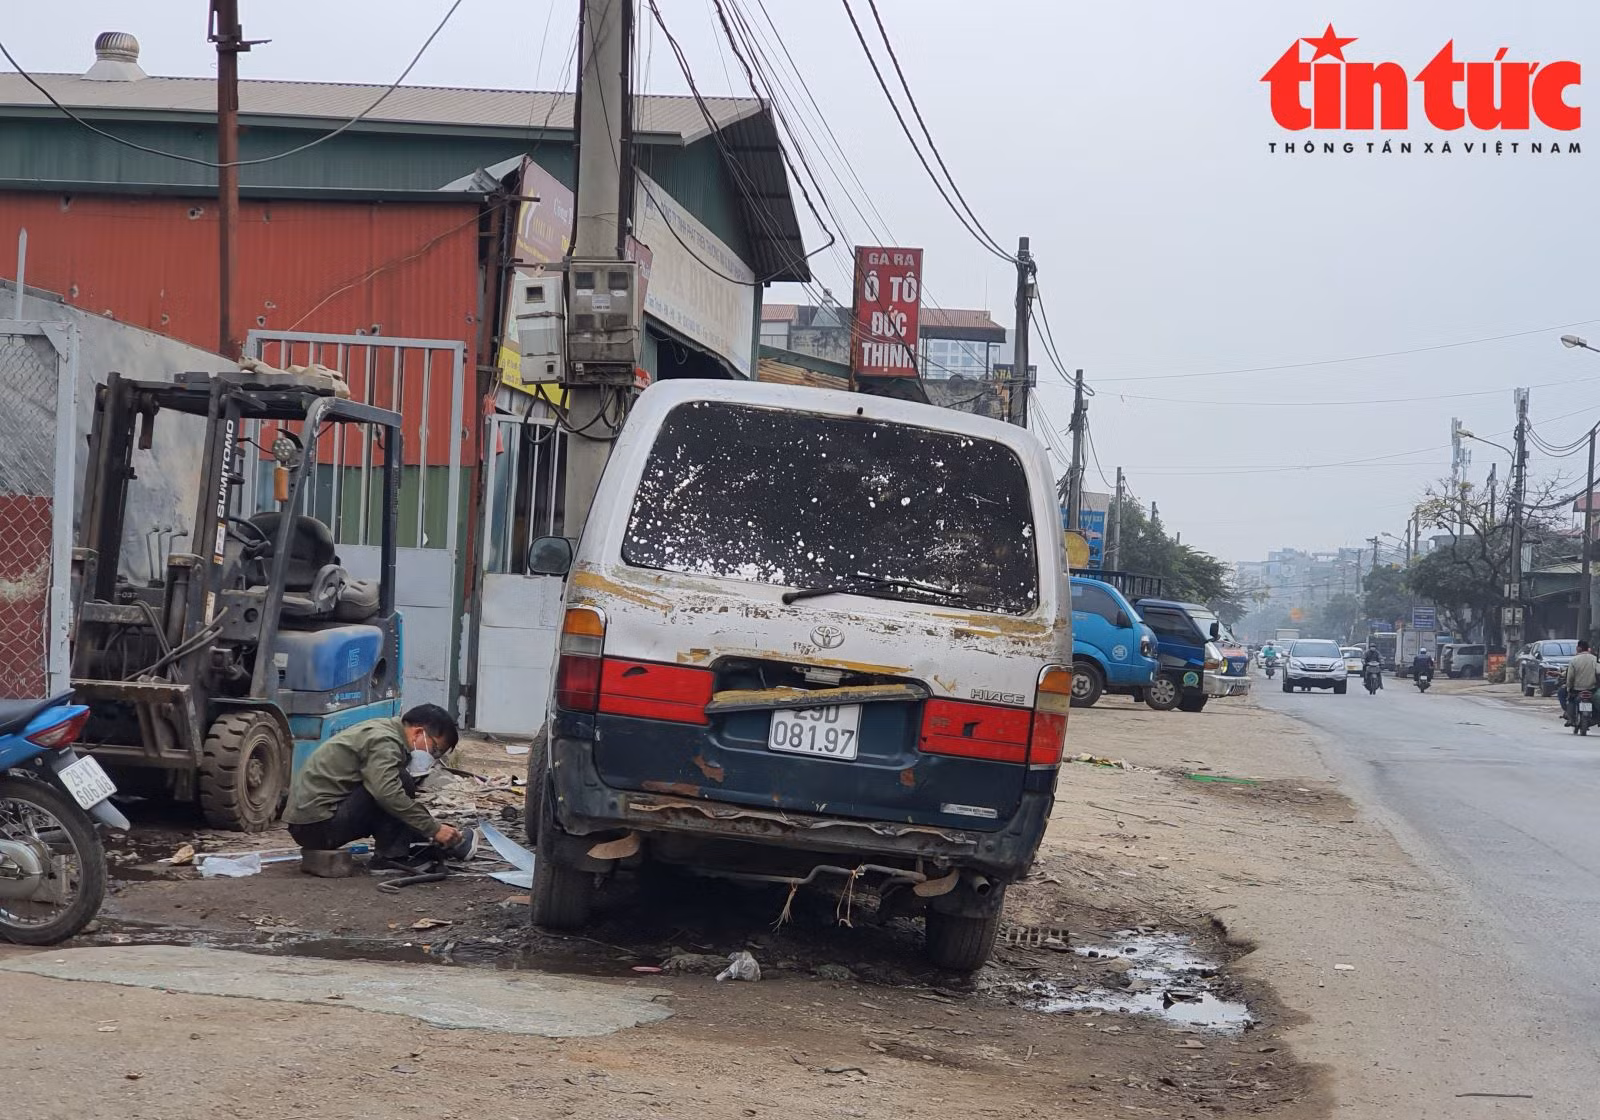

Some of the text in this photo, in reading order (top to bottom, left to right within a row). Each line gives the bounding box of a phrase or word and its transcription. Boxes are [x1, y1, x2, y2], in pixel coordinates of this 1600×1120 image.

[869, 253, 914, 266] GA RA
[864, 270, 917, 303] Ô TÔ
[872, 305, 907, 337] ĐỨC
[862, 342, 915, 372] THỊNH
[216, 419, 234, 518] SUMITOMO
[970, 689, 1025, 705] HIACE
[774, 721, 855, 754] 081.97
[76, 775, 113, 805] 606.08
